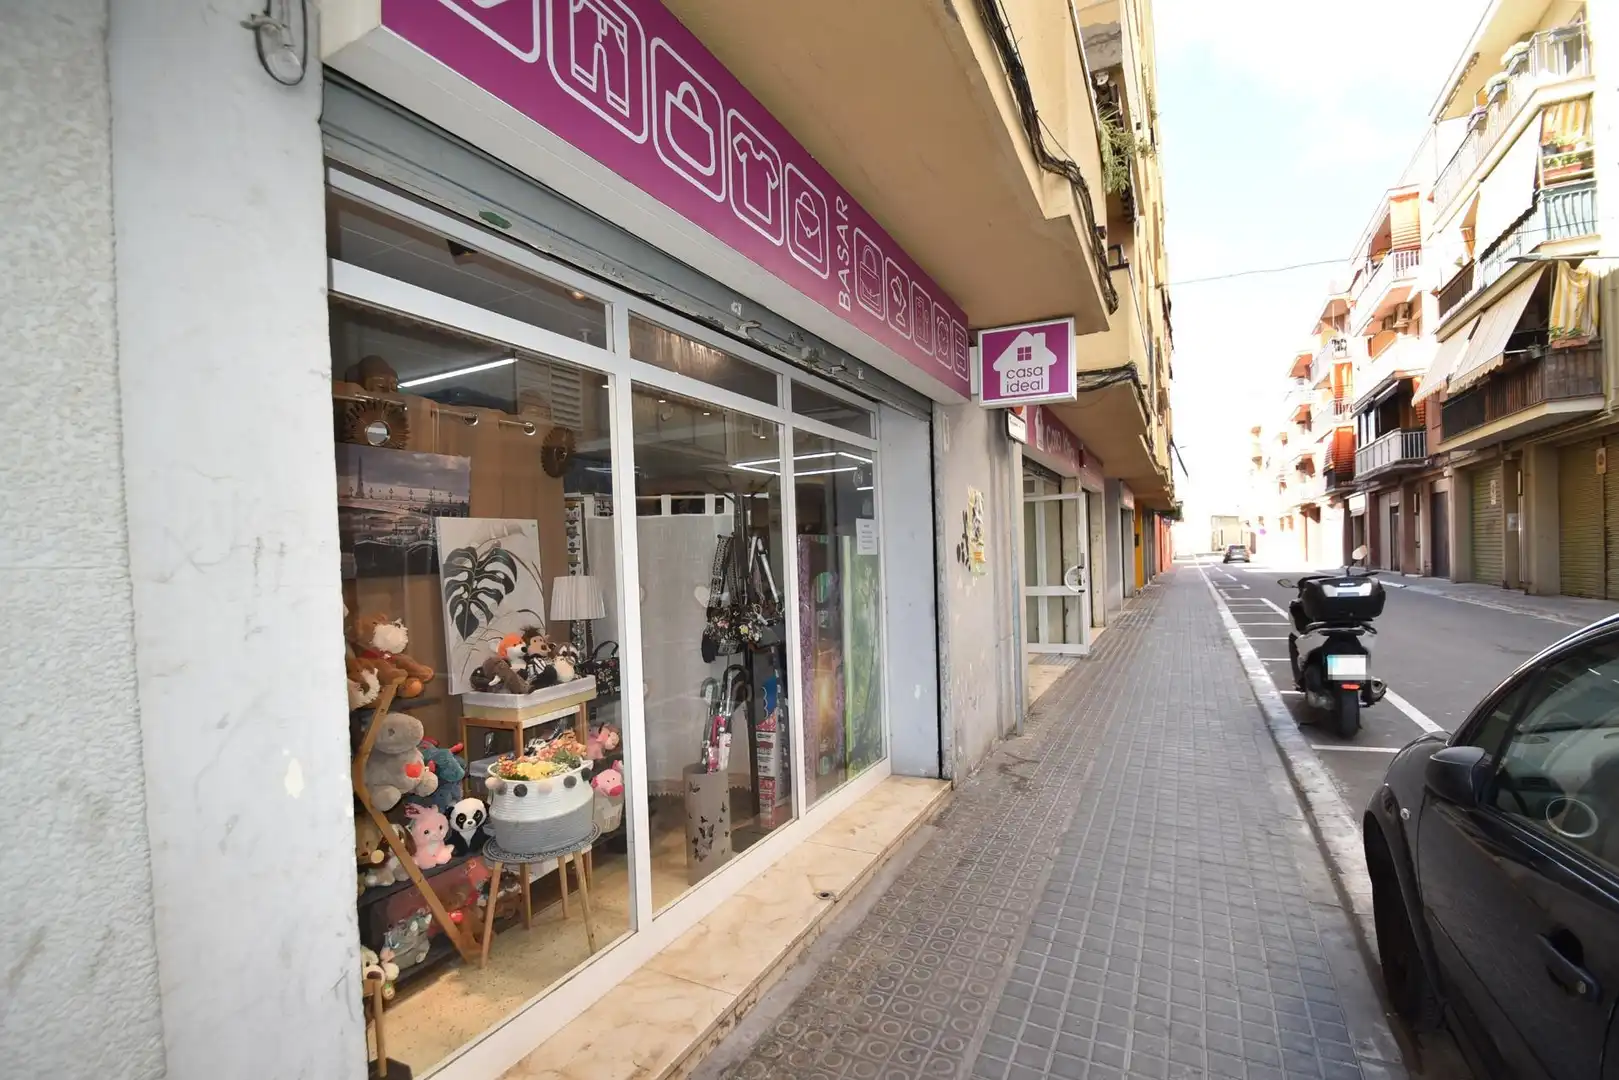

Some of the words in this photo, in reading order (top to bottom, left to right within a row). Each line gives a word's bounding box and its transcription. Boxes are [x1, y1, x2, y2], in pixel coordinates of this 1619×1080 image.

[836, 195, 851, 312] BASAR
[1006, 366, 1043, 379] casa
[1006, 377, 1043, 393] ideal
